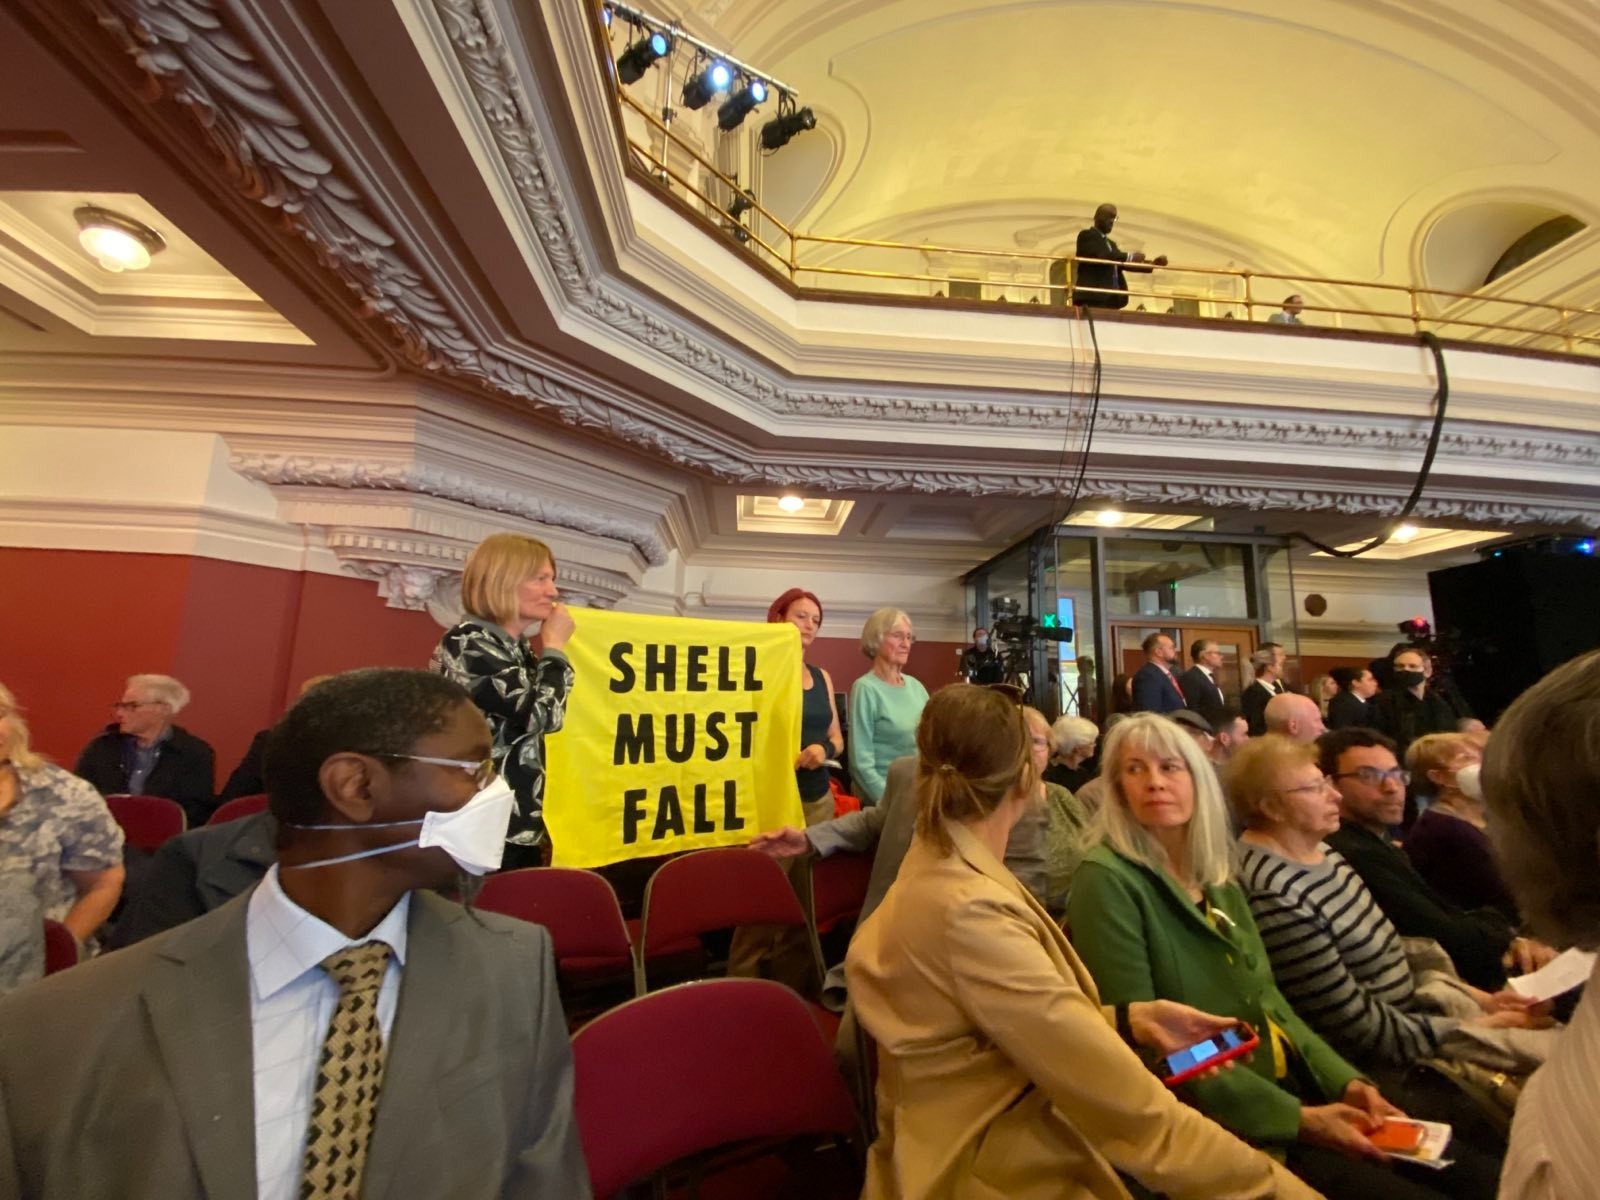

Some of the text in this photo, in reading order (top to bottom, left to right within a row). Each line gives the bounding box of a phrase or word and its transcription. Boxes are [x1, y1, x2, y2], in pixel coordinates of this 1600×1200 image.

[609, 641, 763, 694] SHELL
[613, 711, 758, 766] MUST
[623, 780, 745, 845] FALL
